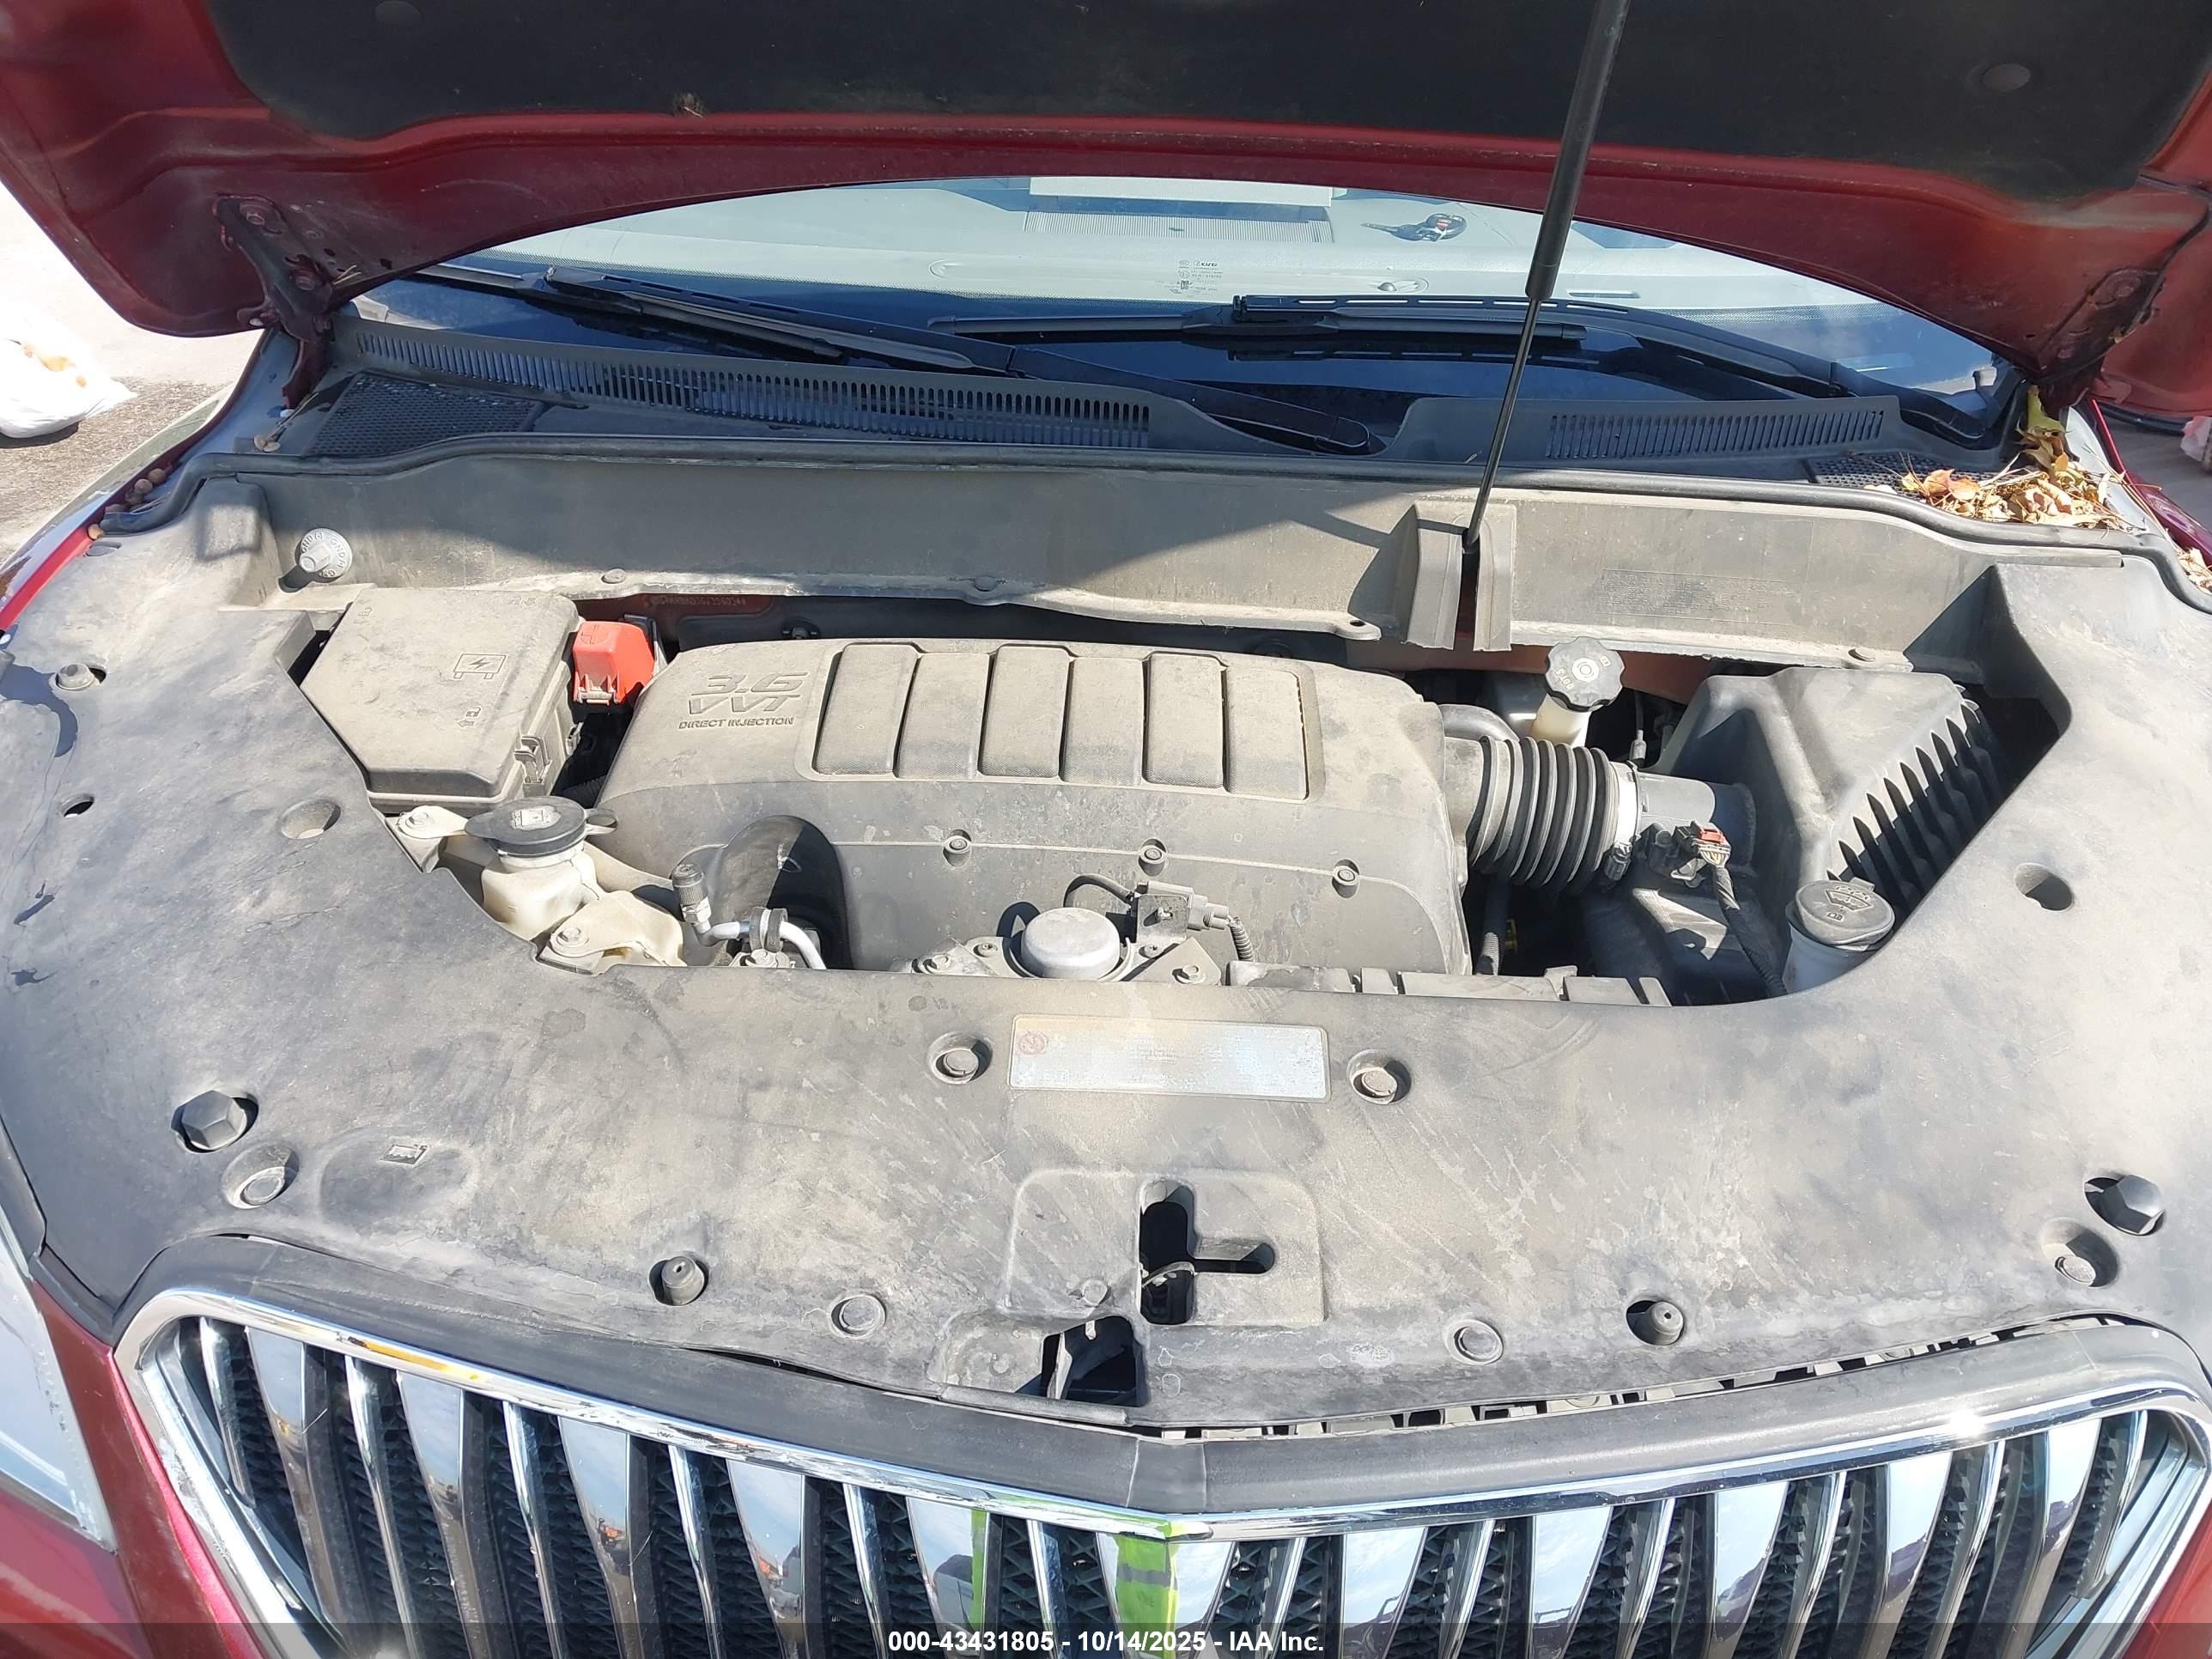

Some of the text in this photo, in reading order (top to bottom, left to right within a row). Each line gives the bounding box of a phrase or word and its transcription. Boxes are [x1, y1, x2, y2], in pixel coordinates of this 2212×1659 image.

[690, 672, 809, 696] 3.6
[688, 694, 801, 715] VVT
[678, 716, 794, 730] DIRECT INJECTION
